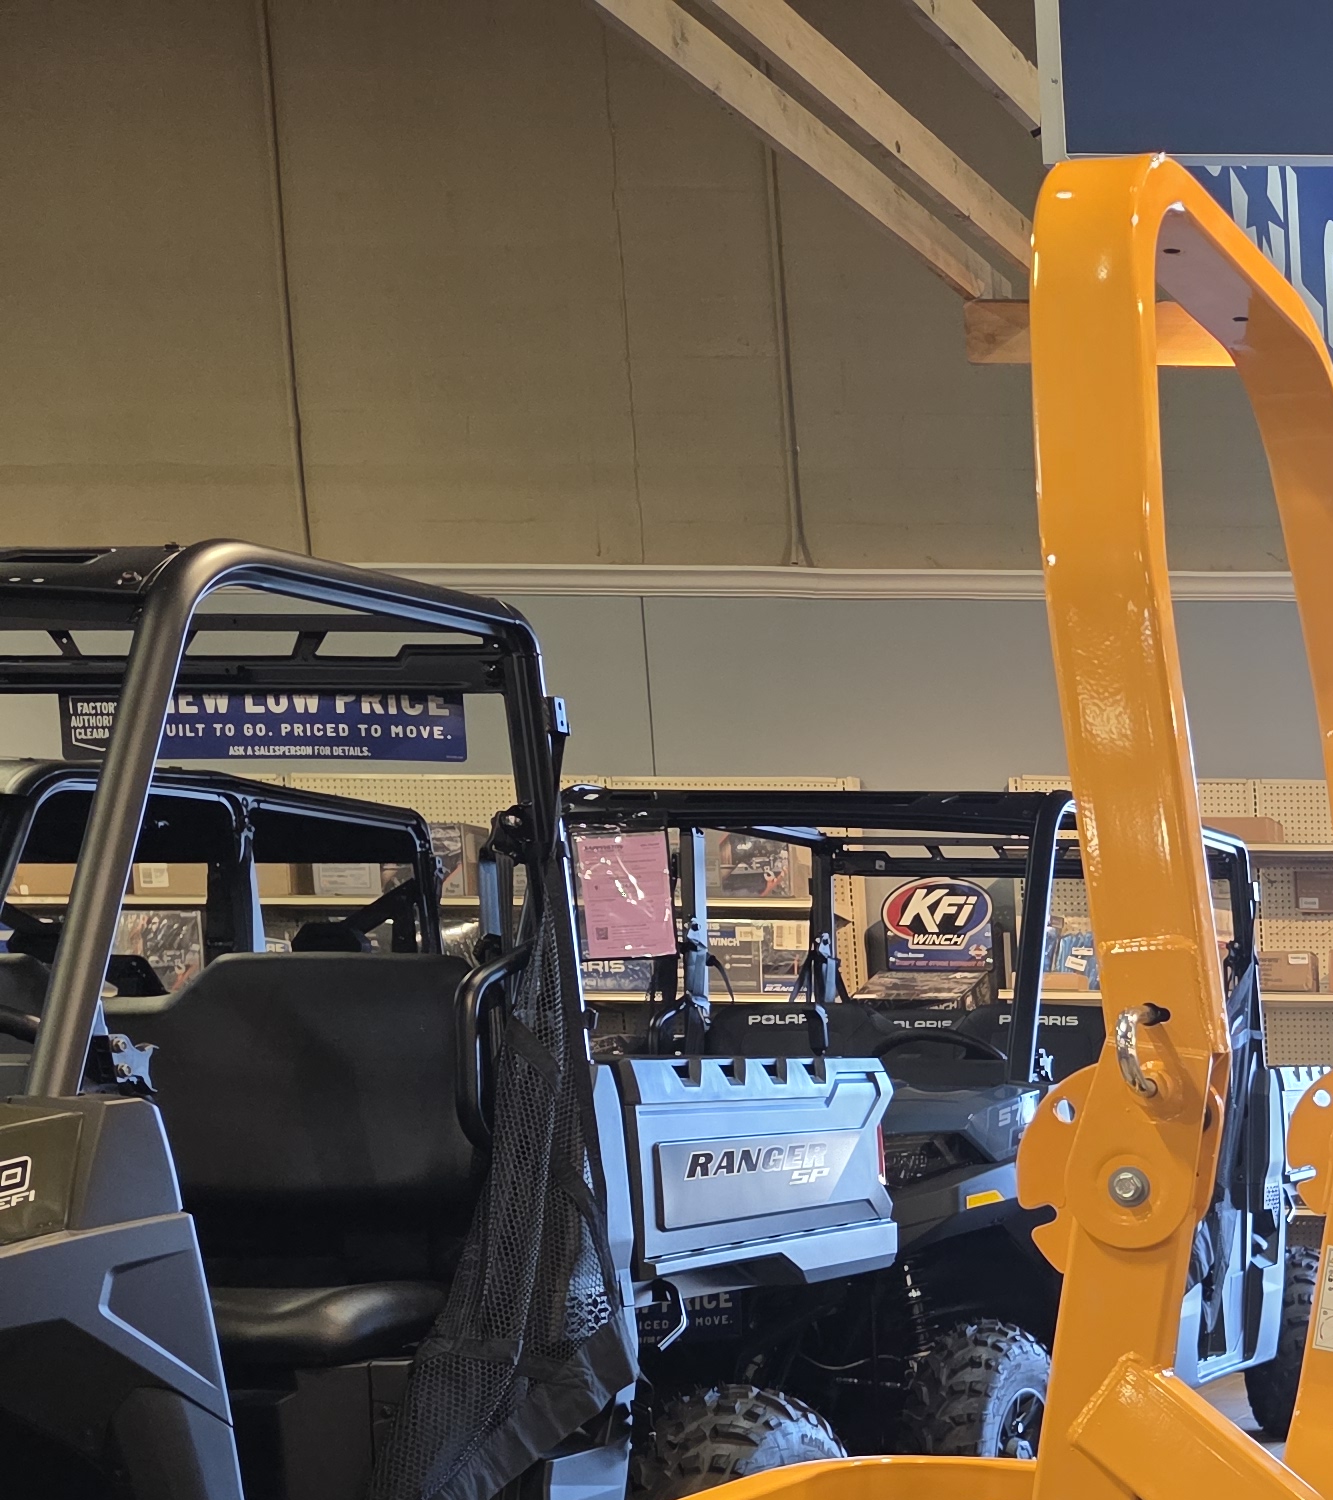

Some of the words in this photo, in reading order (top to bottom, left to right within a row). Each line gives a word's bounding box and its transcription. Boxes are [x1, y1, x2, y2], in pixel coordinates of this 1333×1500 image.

[77, 702, 117, 714] FACTOR
[166, 724, 205, 736] UILT
[213, 724, 235, 737] TO
[244, 724, 273, 737] GO.
[281, 724, 349, 738] PRICED
[358, 725, 382, 738] TO
[390, 725, 453, 740] MOVE.
[228, 746, 245, 756] ASK
[247, 746, 253, 756] A
[254, 746, 312, 756] SALESPERSON
[314, 746, 331, 756] FOR
[333, 746, 372, 756] DETAILS.
[913, 934, 965, 945] WINCH
[684, 1142, 827, 1181] RANGER
[789, 1167, 830, 1185] SP
[695, 1315, 733, 1327] MOVE.
